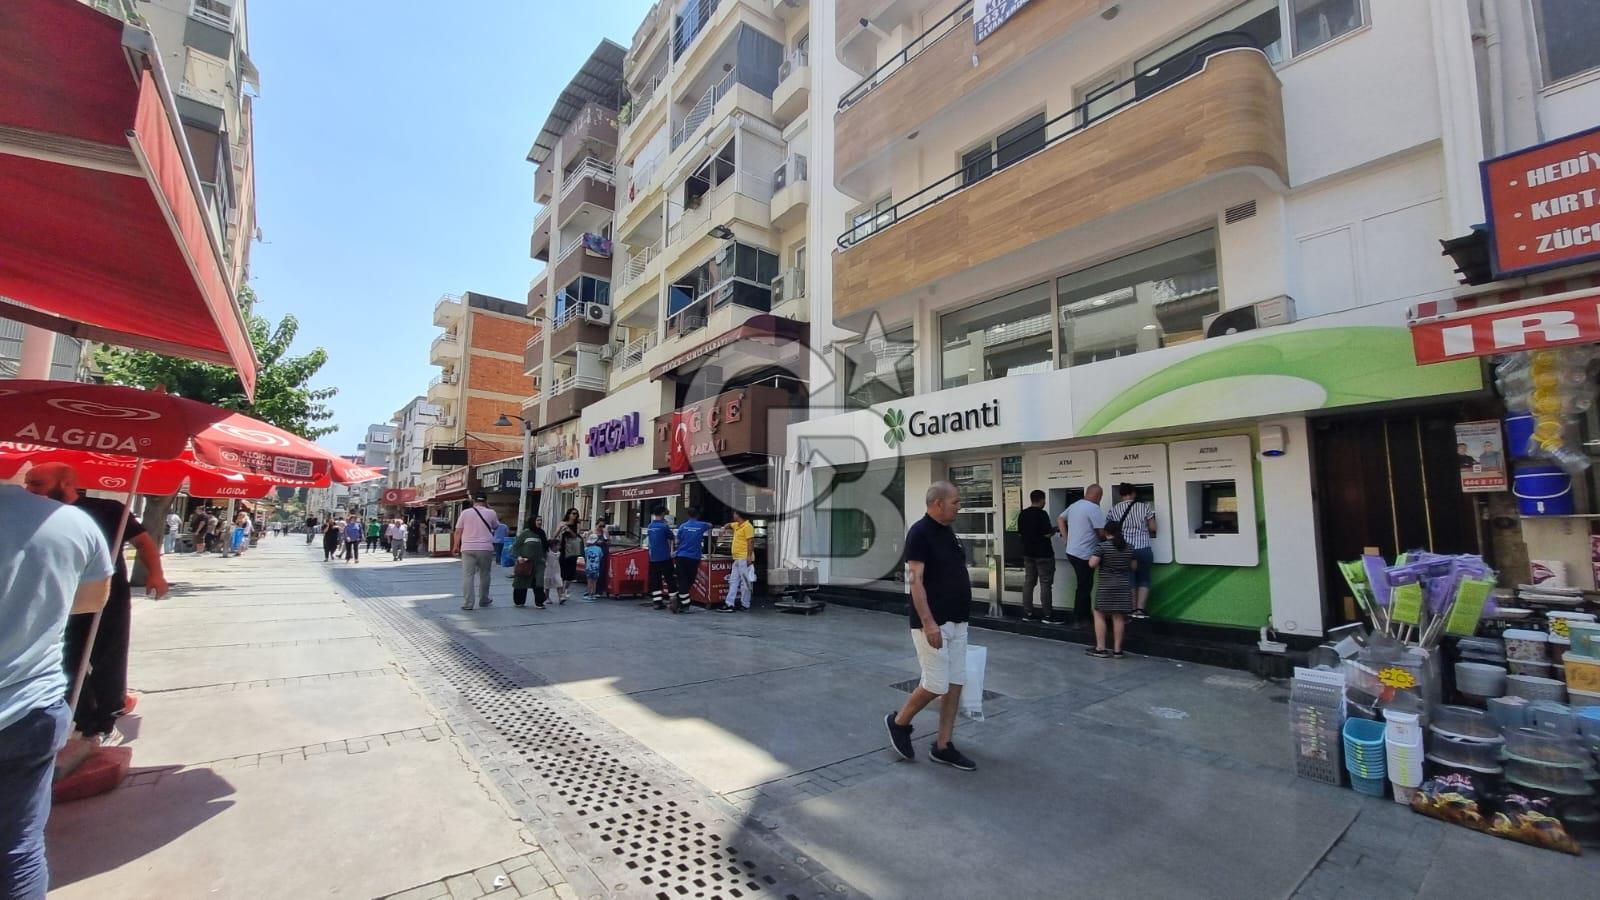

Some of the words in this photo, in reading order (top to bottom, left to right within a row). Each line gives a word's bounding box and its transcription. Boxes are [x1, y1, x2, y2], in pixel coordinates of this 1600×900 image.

[1531, 188, 1599, 221] KIRT
[1442, 306, 1600, 356] IR
[588, 411, 644, 457] REGAL
[908, 399, 1000, 438] Garanti
[1123, 453, 1139, 461] ATM
